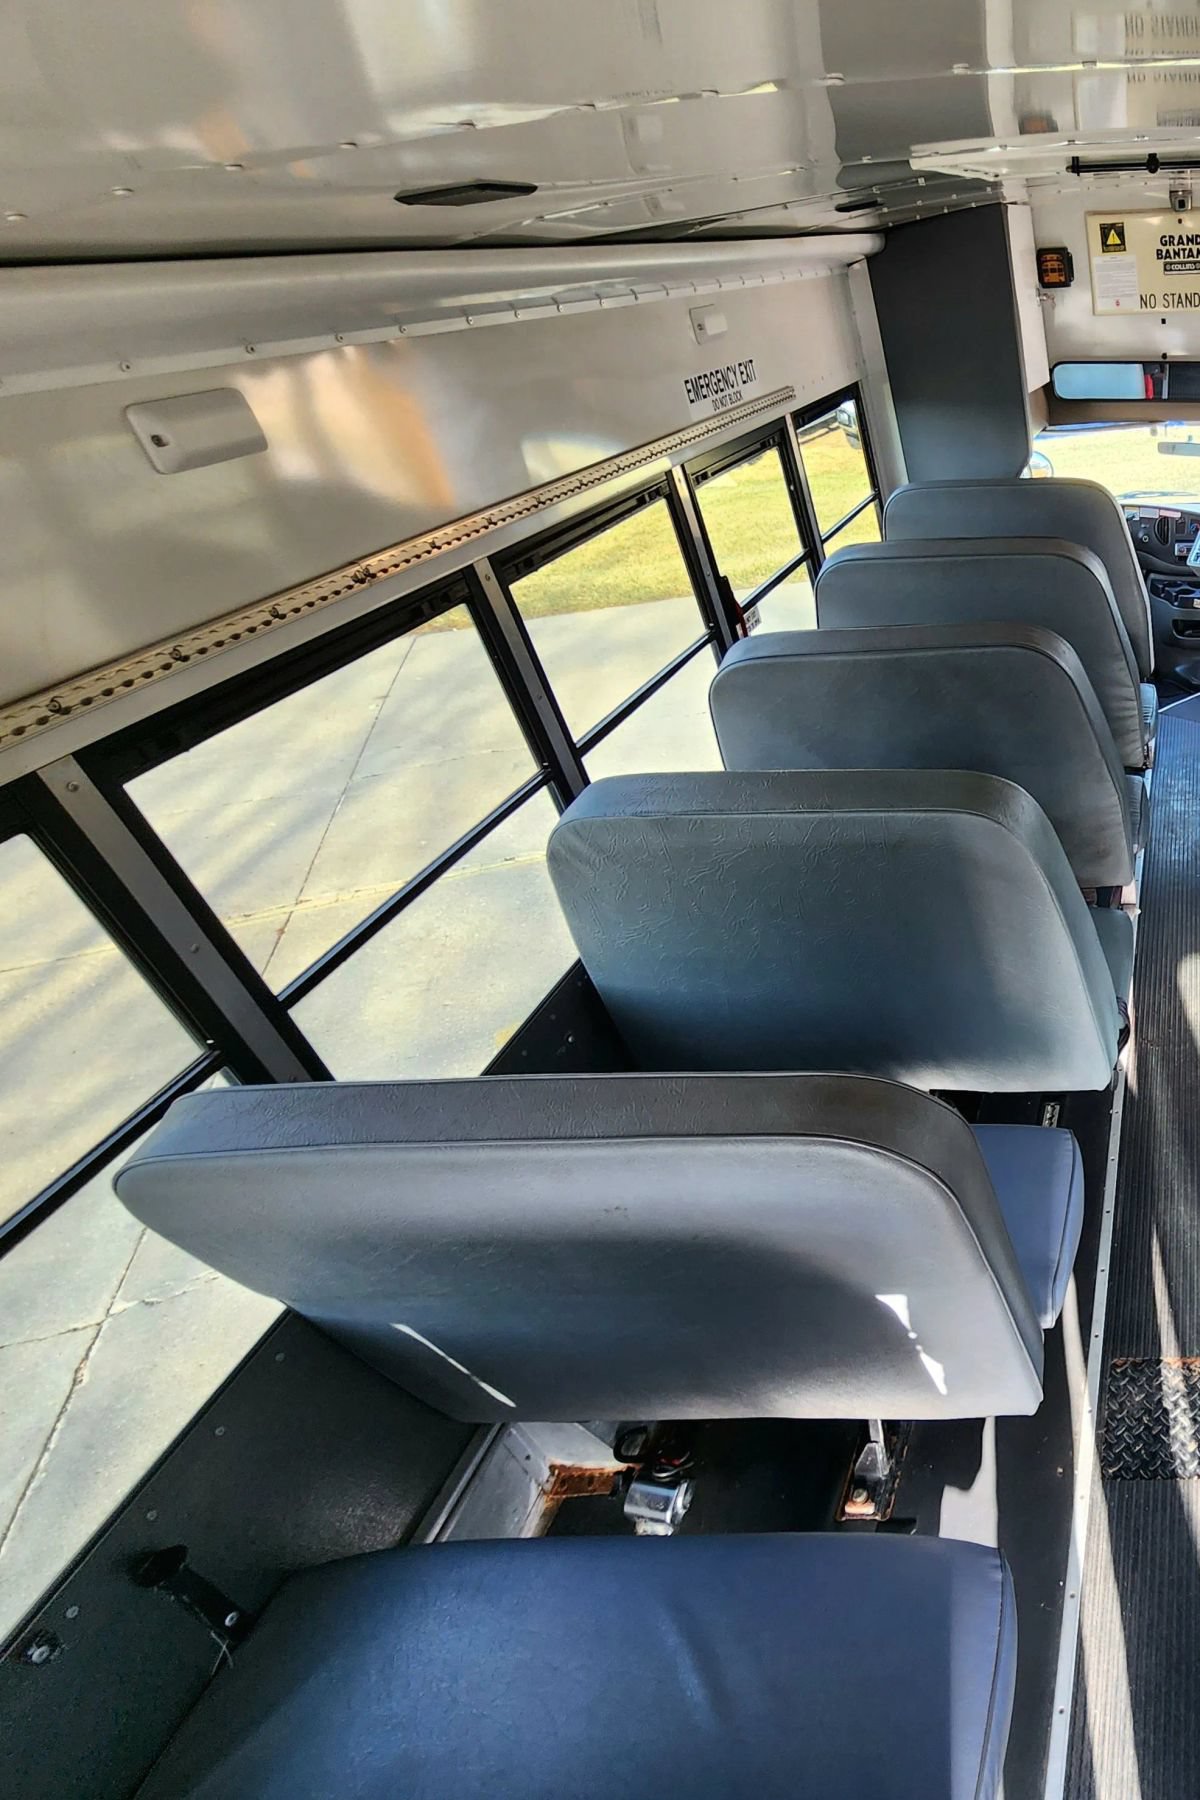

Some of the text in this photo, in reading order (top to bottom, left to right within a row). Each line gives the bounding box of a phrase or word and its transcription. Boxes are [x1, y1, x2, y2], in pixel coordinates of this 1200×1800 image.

[1139, 293, 1157, 309] NO
[684, 359, 757, 404] EMERGENCY EXIT
